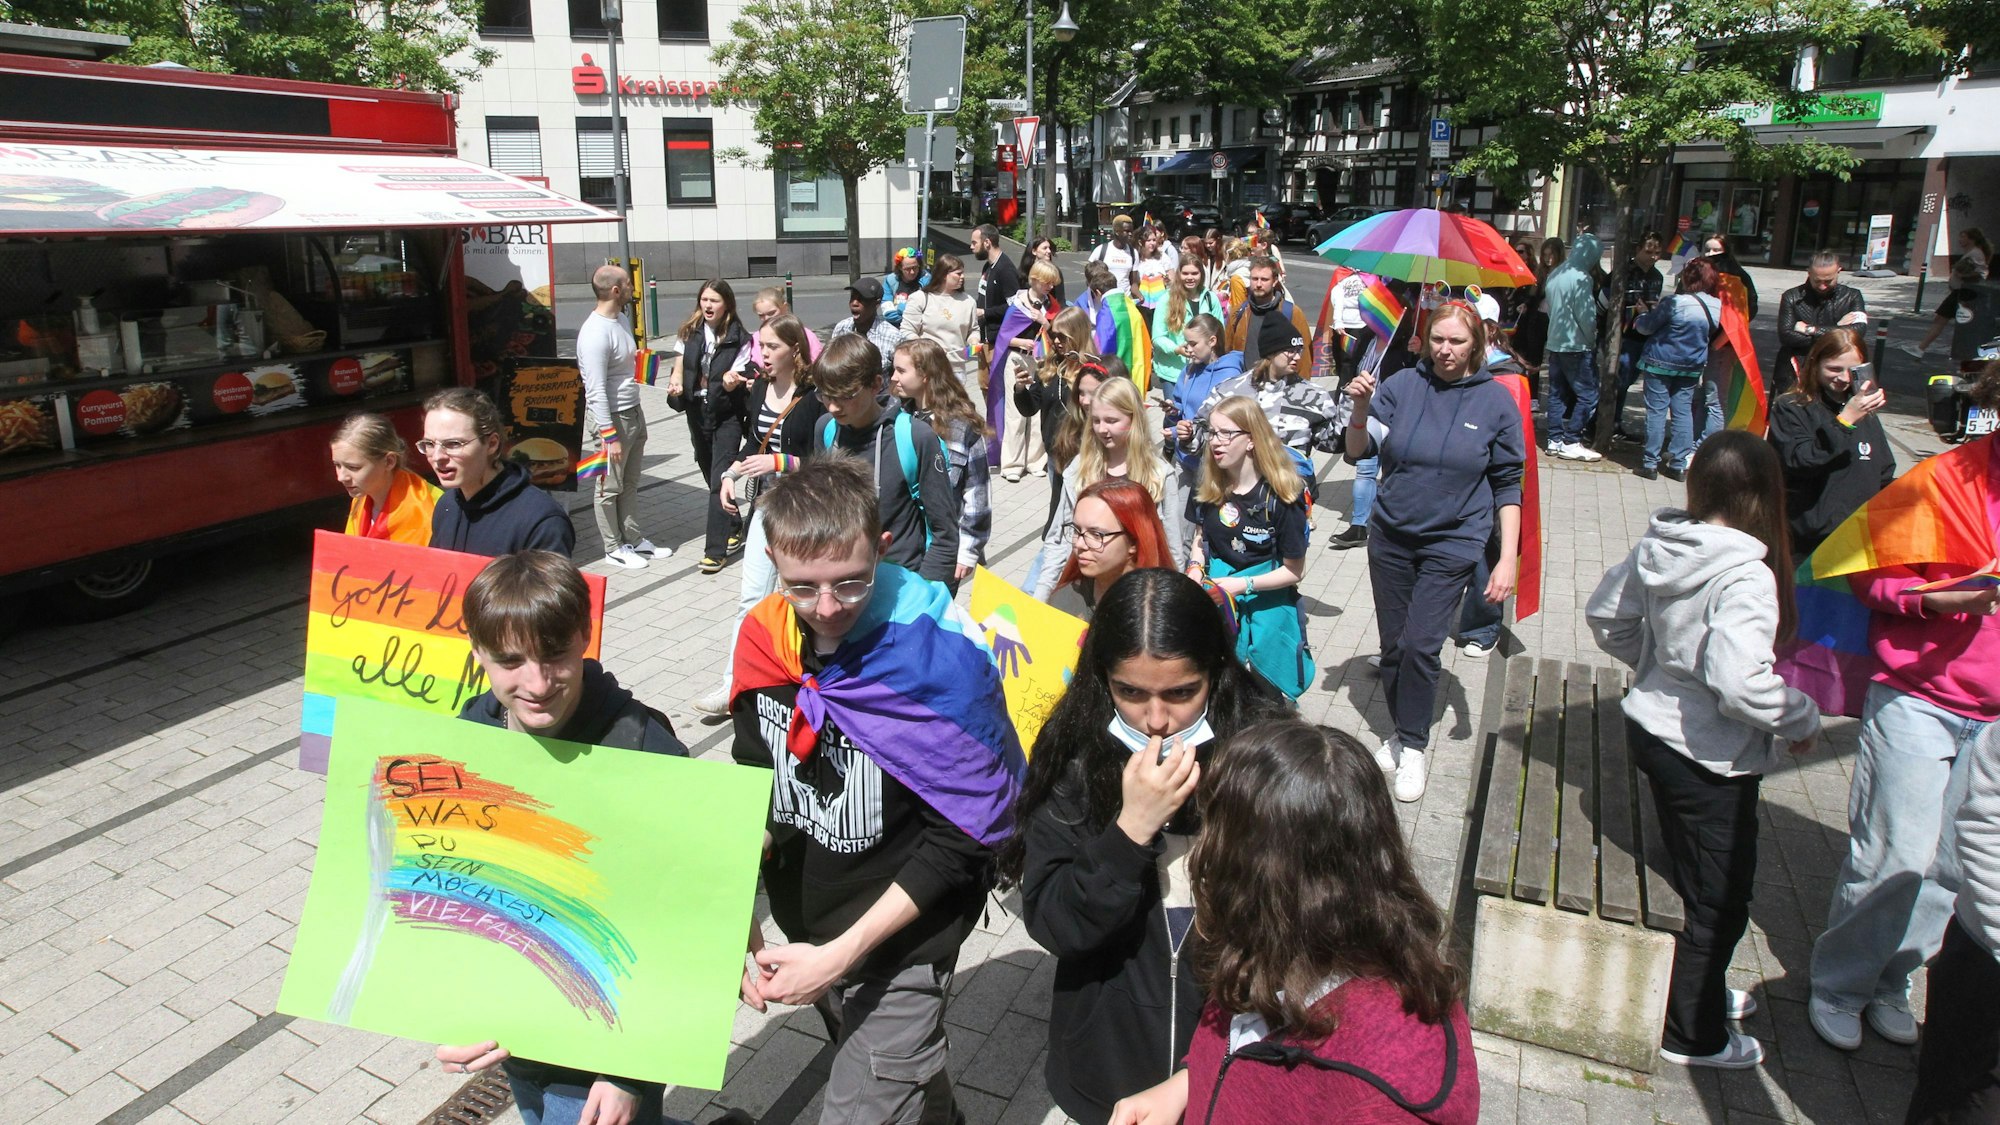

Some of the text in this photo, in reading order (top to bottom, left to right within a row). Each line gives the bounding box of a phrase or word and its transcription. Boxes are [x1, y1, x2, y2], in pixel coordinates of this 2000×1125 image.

[14, 147, 215, 166] BAR
[473, 246, 486, 255] mit
[489, 246, 509, 255] allen
[485, 224, 548, 245] BAR
[81, 401, 124, 413] Currywurst
[84, 415, 124, 426] Pommes
[331, 565, 414, 628] Gott
[352, 636, 440, 703] alle
[757, 693, 794, 732] ABSCH
[386, 759, 463, 798] SEI
[403, 799, 500, 831] WAS
[409, 833, 457, 851] DU
[794, 813, 813, 836] AUS
[814, 823, 830, 848] DEM
[830, 836, 874, 853] SYSTEM
[415, 853, 485, 876] SEIN
[412, 871, 556, 923] MÖCHTEST
[411, 893, 538, 953] VIELFALT
